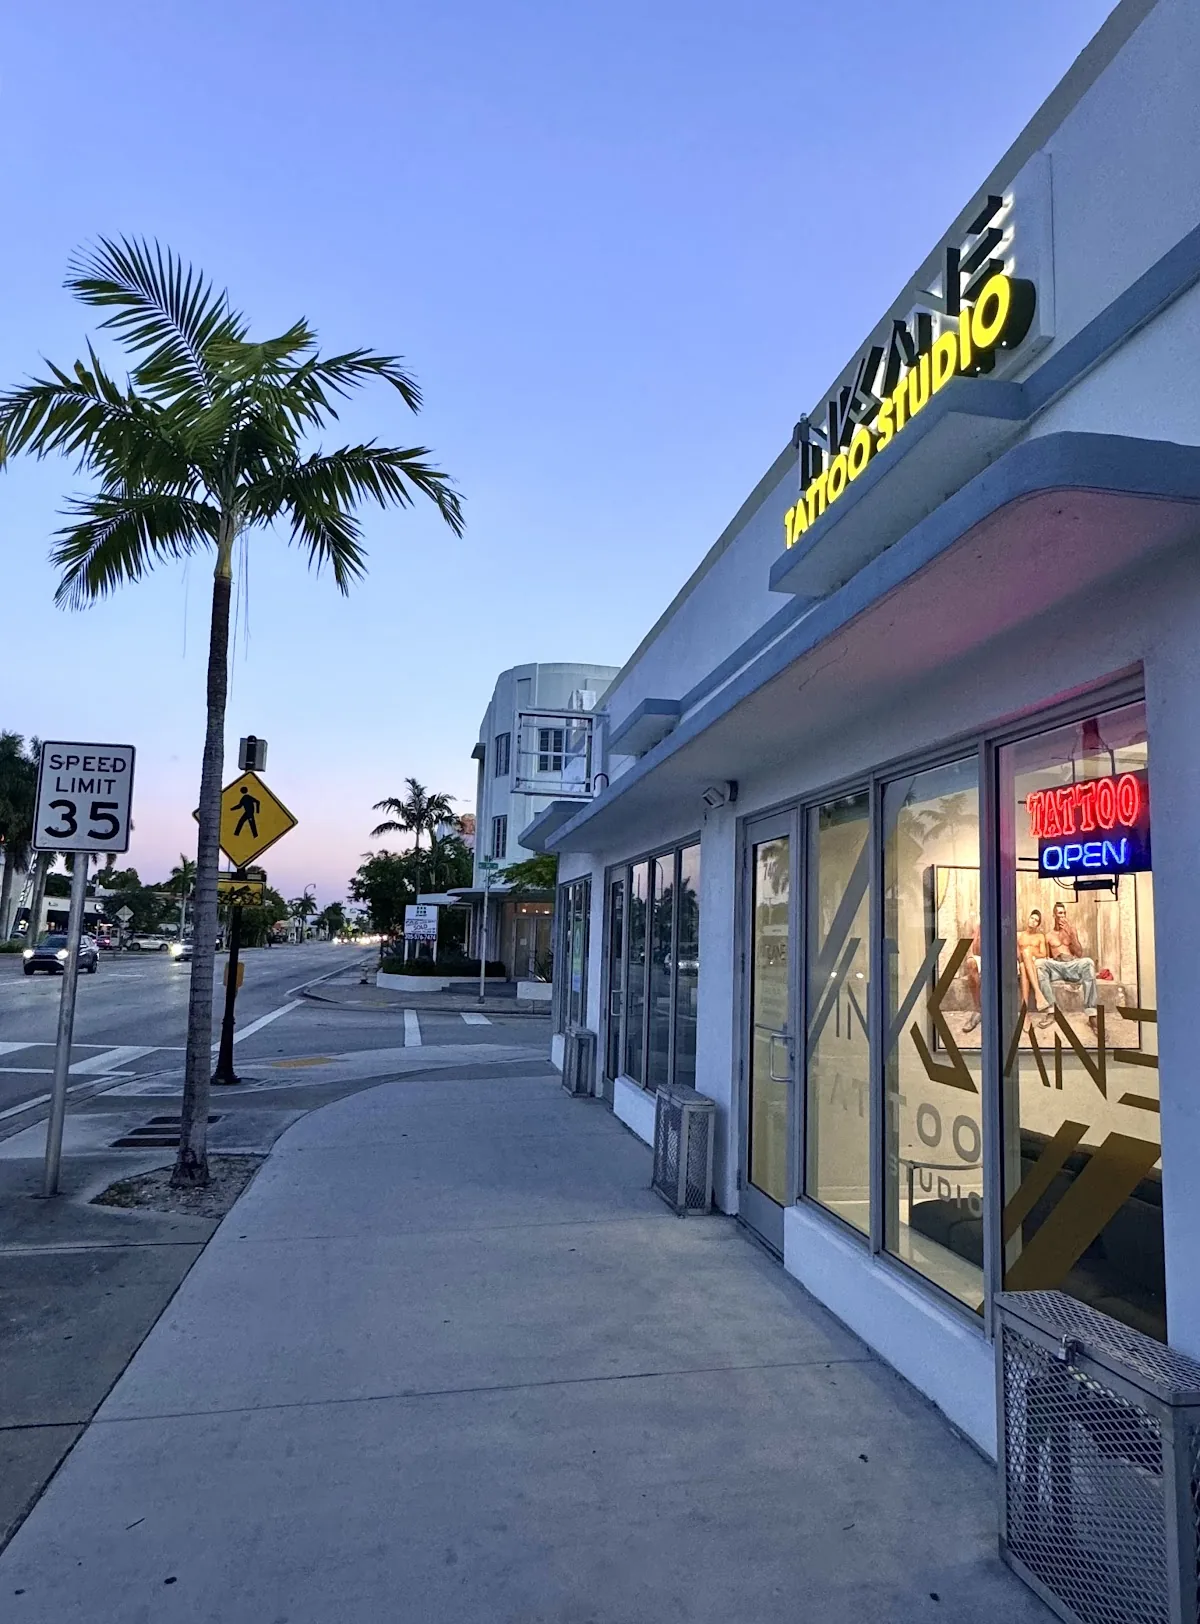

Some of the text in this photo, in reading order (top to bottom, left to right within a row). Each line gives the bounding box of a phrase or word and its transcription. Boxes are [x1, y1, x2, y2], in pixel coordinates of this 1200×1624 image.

[784, 273, 1012, 550] TATTOO STUDIO
[49, 755, 126, 773] SPEED
[56, 777, 116, 794] LIMIT
[45, 800, 119, 840] 35
[1025, 774, 1141, 839] TATTOO
[1042, 837, 1128, 871] OPEN
